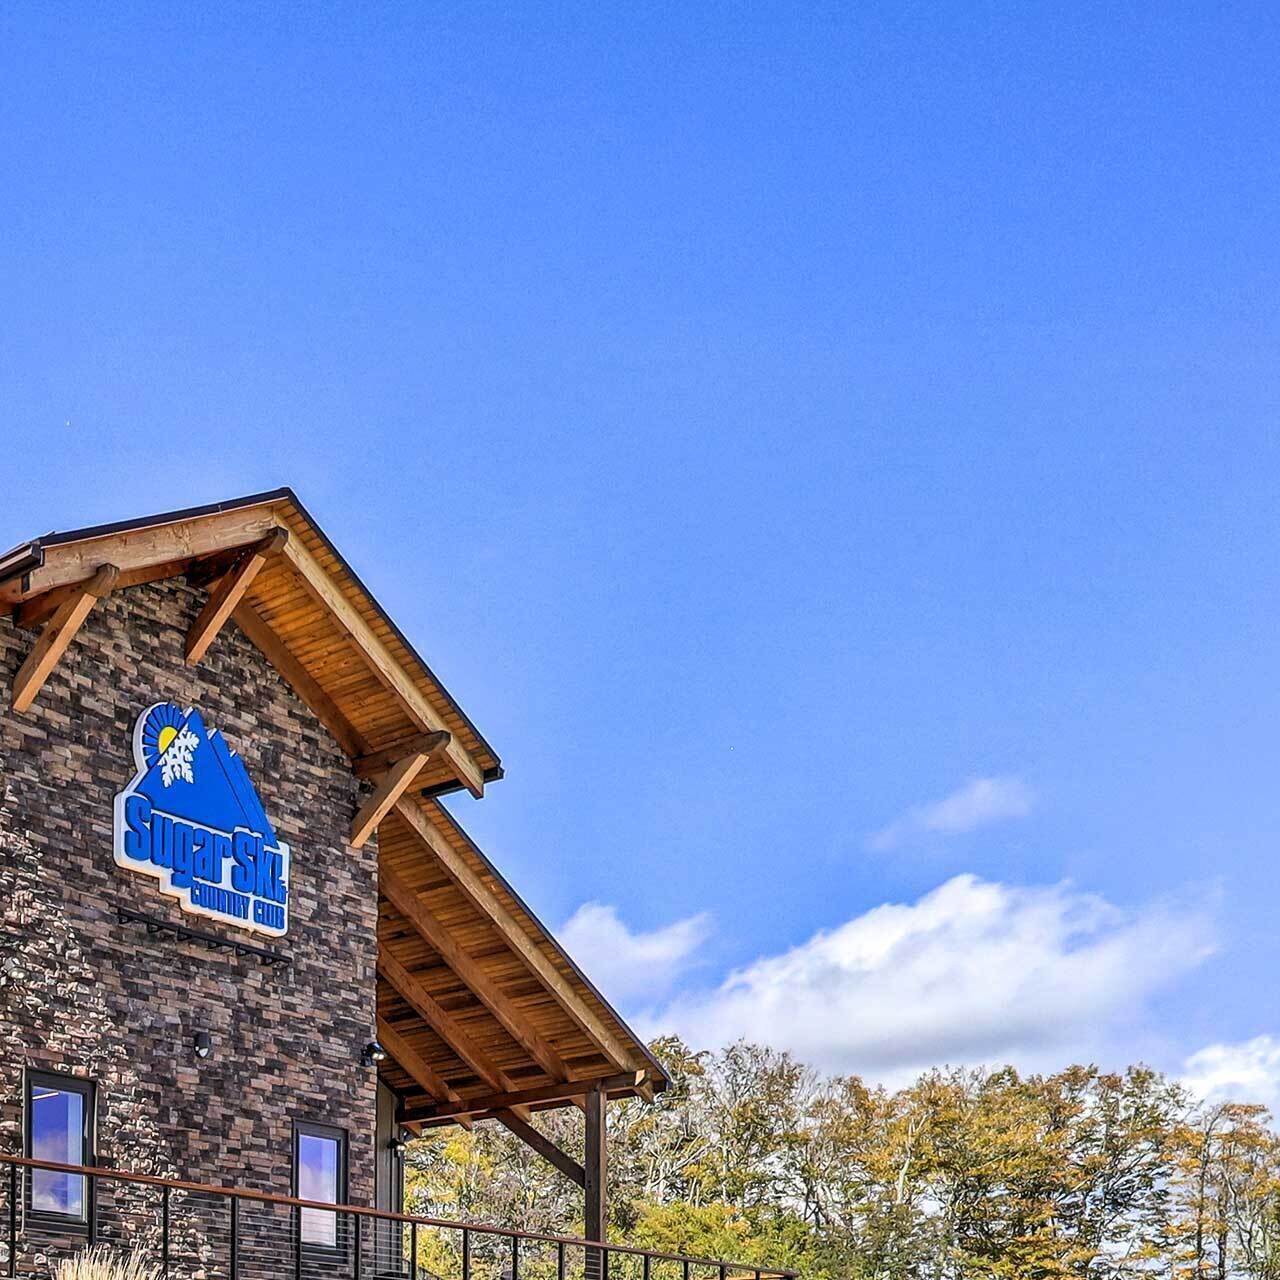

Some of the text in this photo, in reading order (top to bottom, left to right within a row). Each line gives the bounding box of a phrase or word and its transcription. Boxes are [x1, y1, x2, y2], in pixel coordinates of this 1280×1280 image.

[124, 796, 231, 888] Sugar
[191, 881, 250, 919] COUNTRY
[253, 900, 285, 929] CLUB
